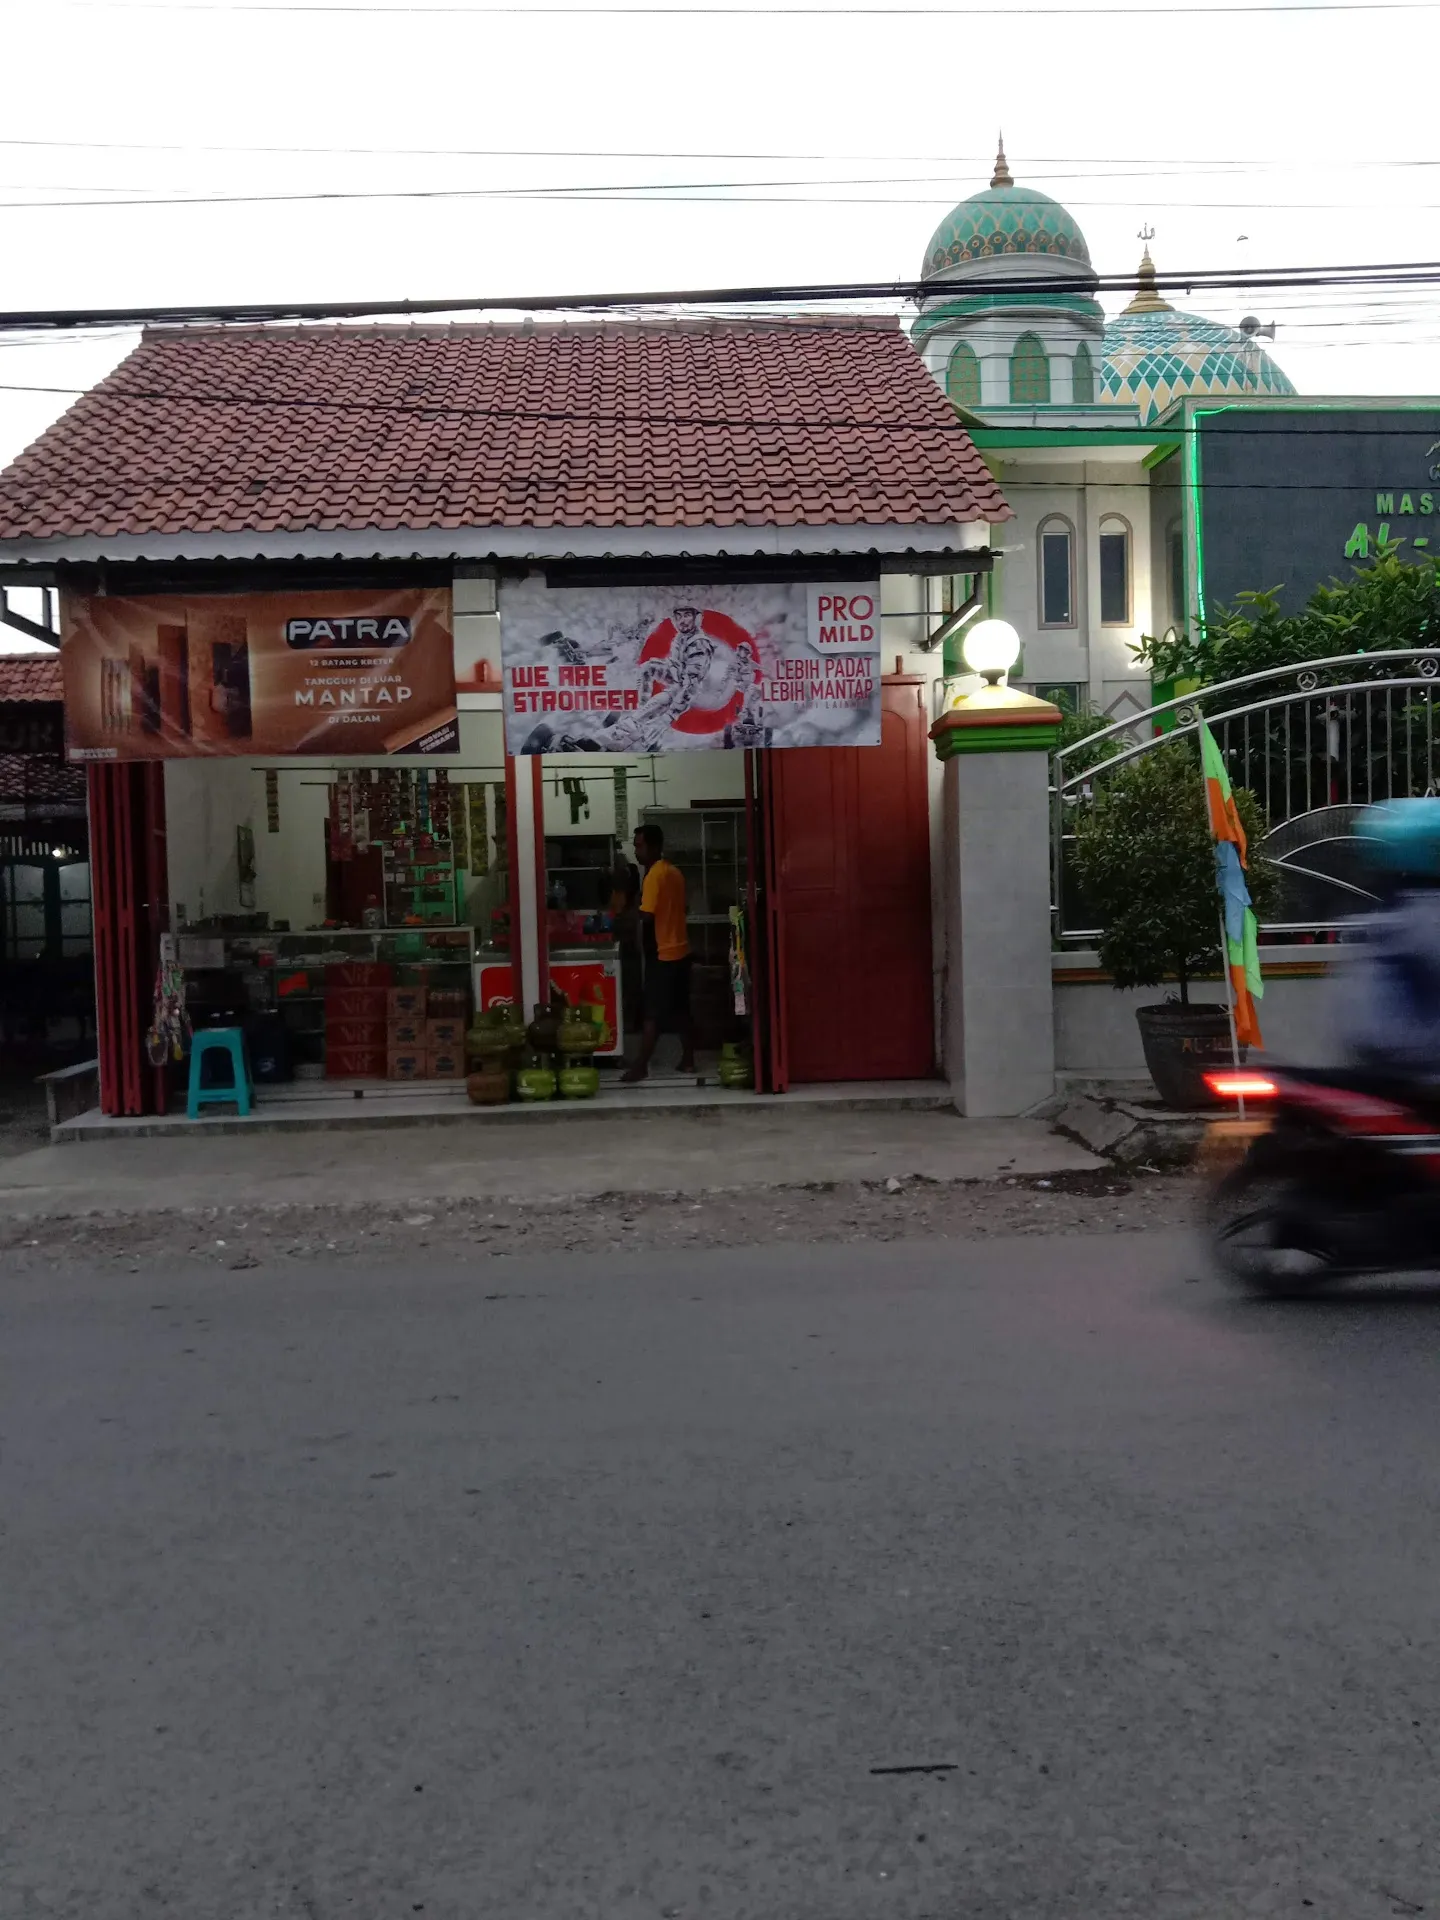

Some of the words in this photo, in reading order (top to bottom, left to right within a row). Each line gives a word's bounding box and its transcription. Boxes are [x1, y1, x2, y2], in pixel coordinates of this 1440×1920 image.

[1376, 493, 1440, 515] MAS
[818, 595, 874, 621] PRO
[289, 619, 409, 641] PATRA
[819, 625, 874, 643] MILD
[512, 666, 549, 688] WE
[558, 665, 607, 687] ARE
[776, 659, 819, 680] LEBIH
[825, 657, 873, 678] PADAT
[304, 678, 356, 686] TANGGUH
[374, 675, 401, 683] LUAR
[761, 681, 804, 702] LEBIH
[810, 679, 873, 700] MANTAP
[295, 686, 413, 706] MANTAP
[513, 690, 639, 713] STRONGER
[343, 715, 381, 723] DALAM
